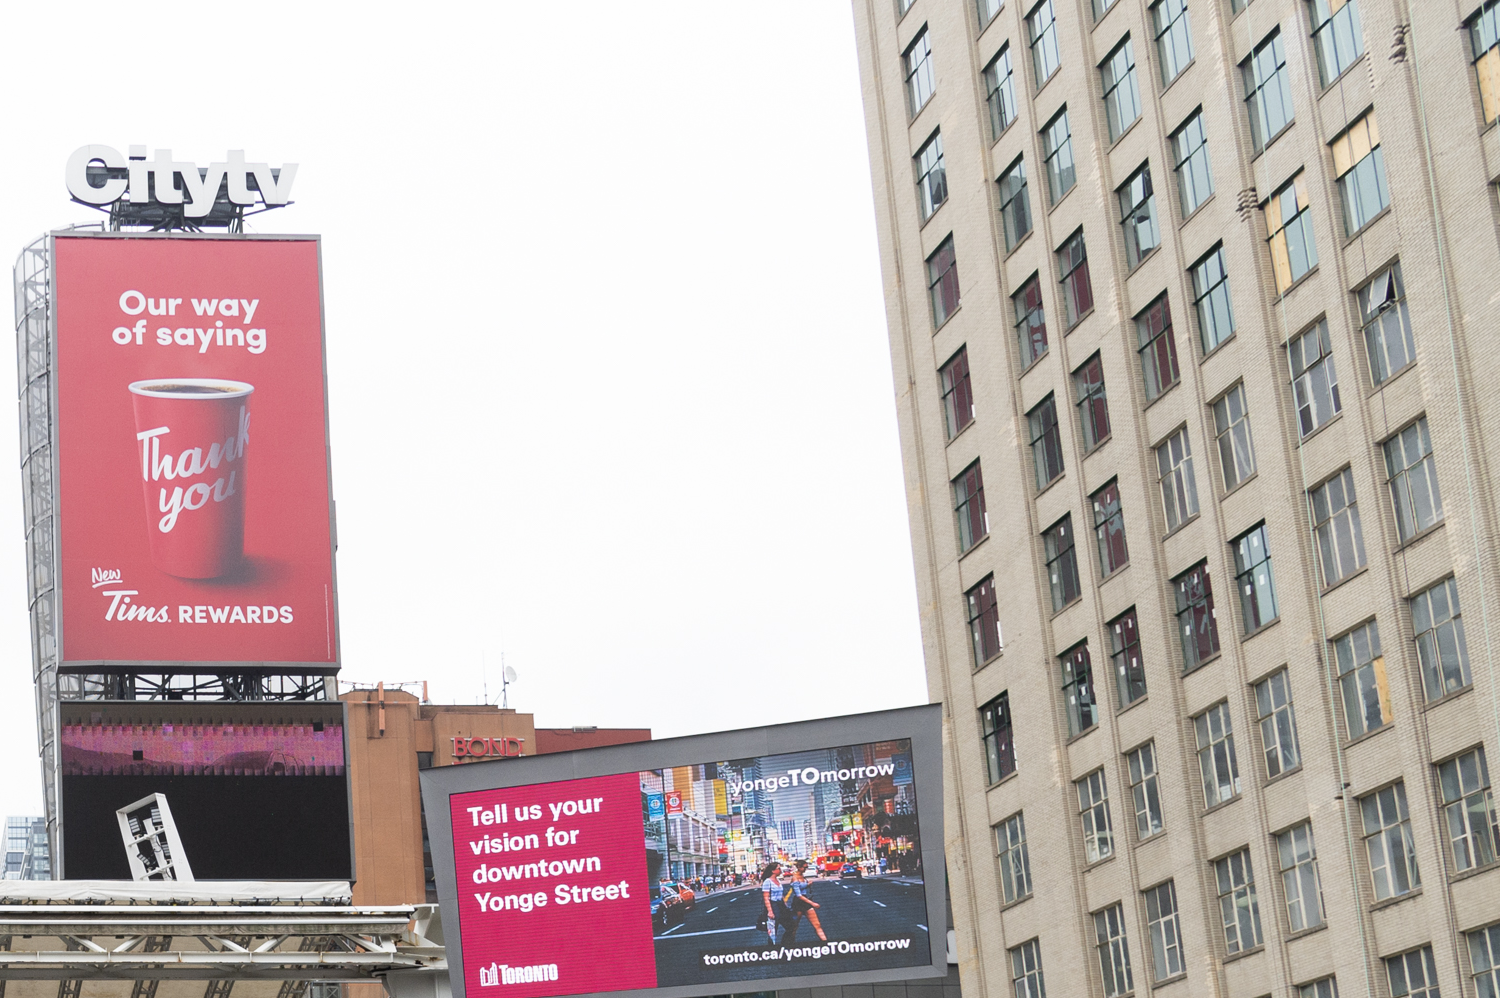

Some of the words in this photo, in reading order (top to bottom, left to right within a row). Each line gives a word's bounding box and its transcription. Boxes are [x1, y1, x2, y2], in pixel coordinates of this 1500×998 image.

[65, 144, 299, 218] Citytv
[119, 290, 182, 315] Our
[191, 298, 259, 324] way
[112, 319, 147, 345] of
[156, 320, 267, 354] saying
[137, 405, 250, 482] Thank
[159, 471, 235, 533] you
[91, 567, 121, 584] New
[102, 590, 170, 623] Tims
[178, 606, 293, 624] REWARDS
[454, 737, 523, 756] BOND
[732, 763, 895, 796] yongeTOmorrow
[467, 804, 508, 826] Tell
[515, 805, 542, 821] us
[549, 797, 603, 821] your
[470, 832, 539, 855] vision
[545, 827, 579, 847] for
[472, 856, 601, 884] downtown
[474, 891, 547, 913] Yonge
[554, 880, 630, 905] Street
[703, 938, 910, 965] toronto.ca/yongeTOmorrow
